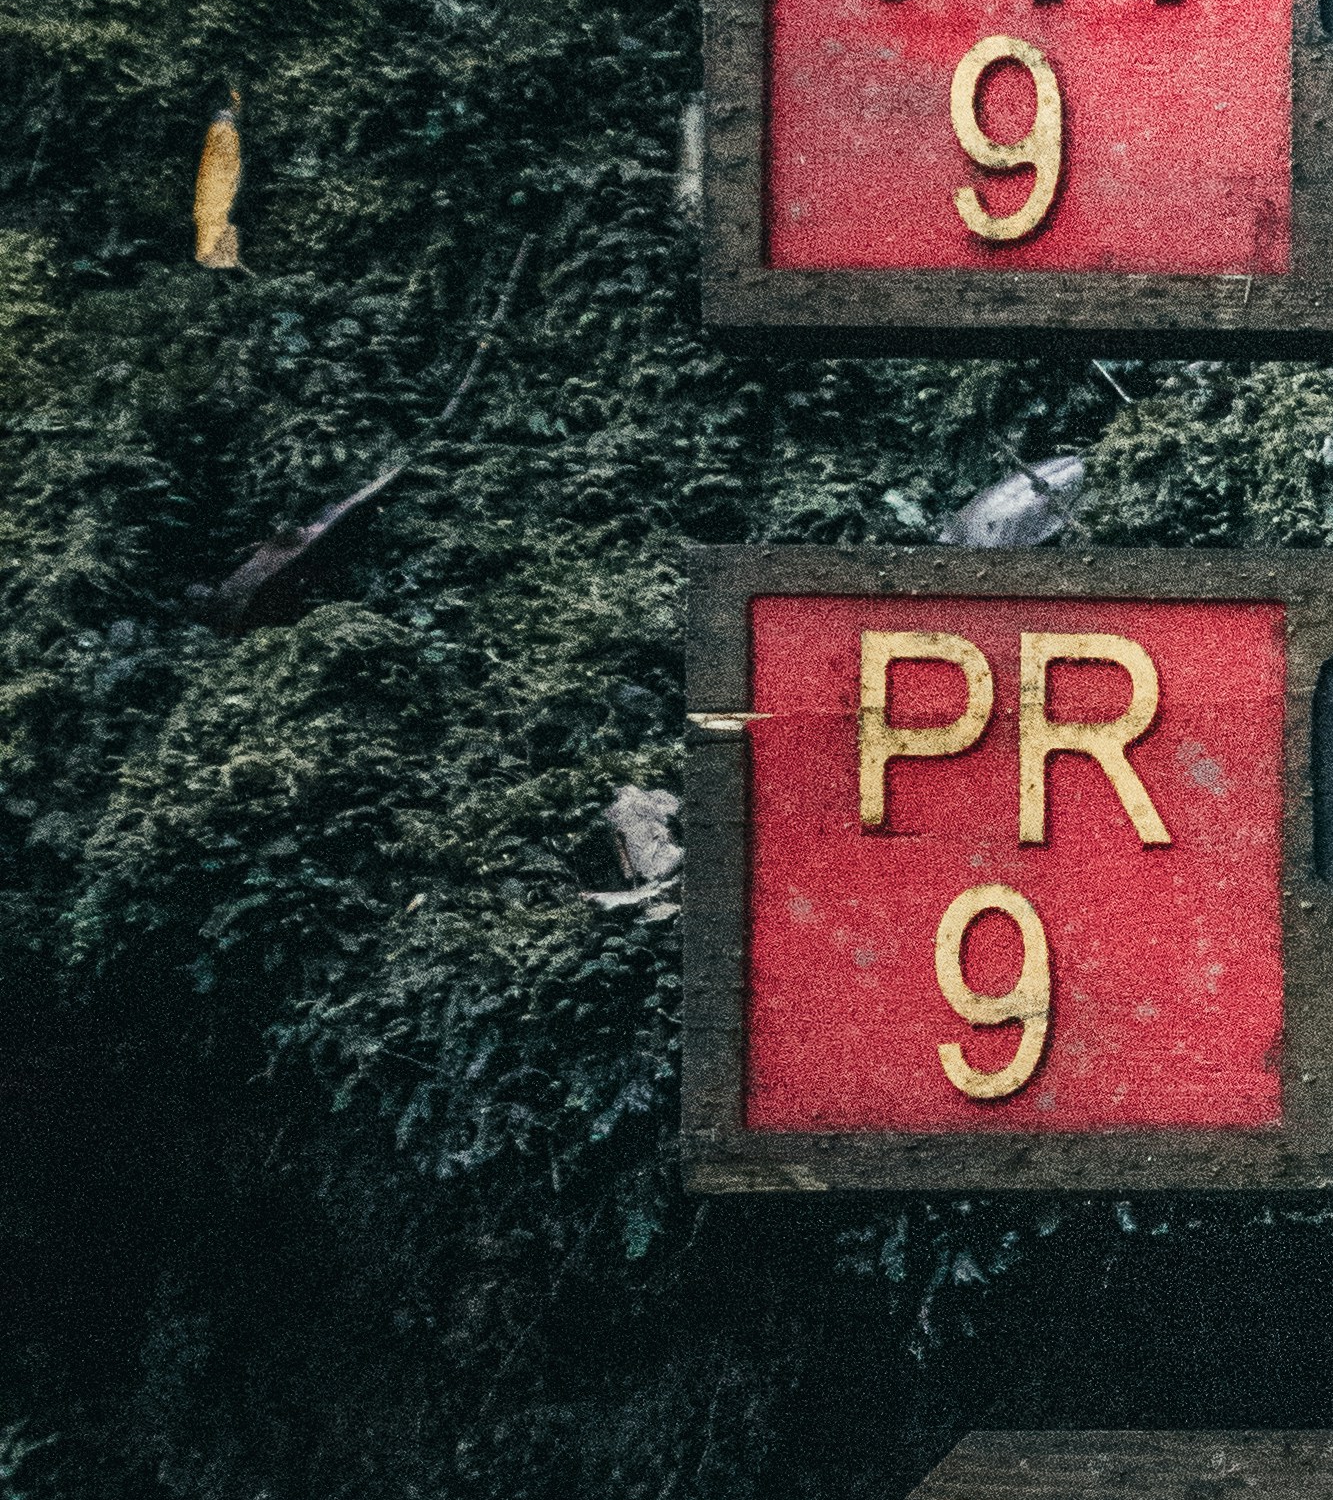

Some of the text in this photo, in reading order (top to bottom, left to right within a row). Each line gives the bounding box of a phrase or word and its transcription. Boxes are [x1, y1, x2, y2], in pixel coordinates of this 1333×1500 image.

[948, 35, 1065, 244] 9
[856, 628, 1172, 847] PR
[933, 884, 1053, 1101] 9
